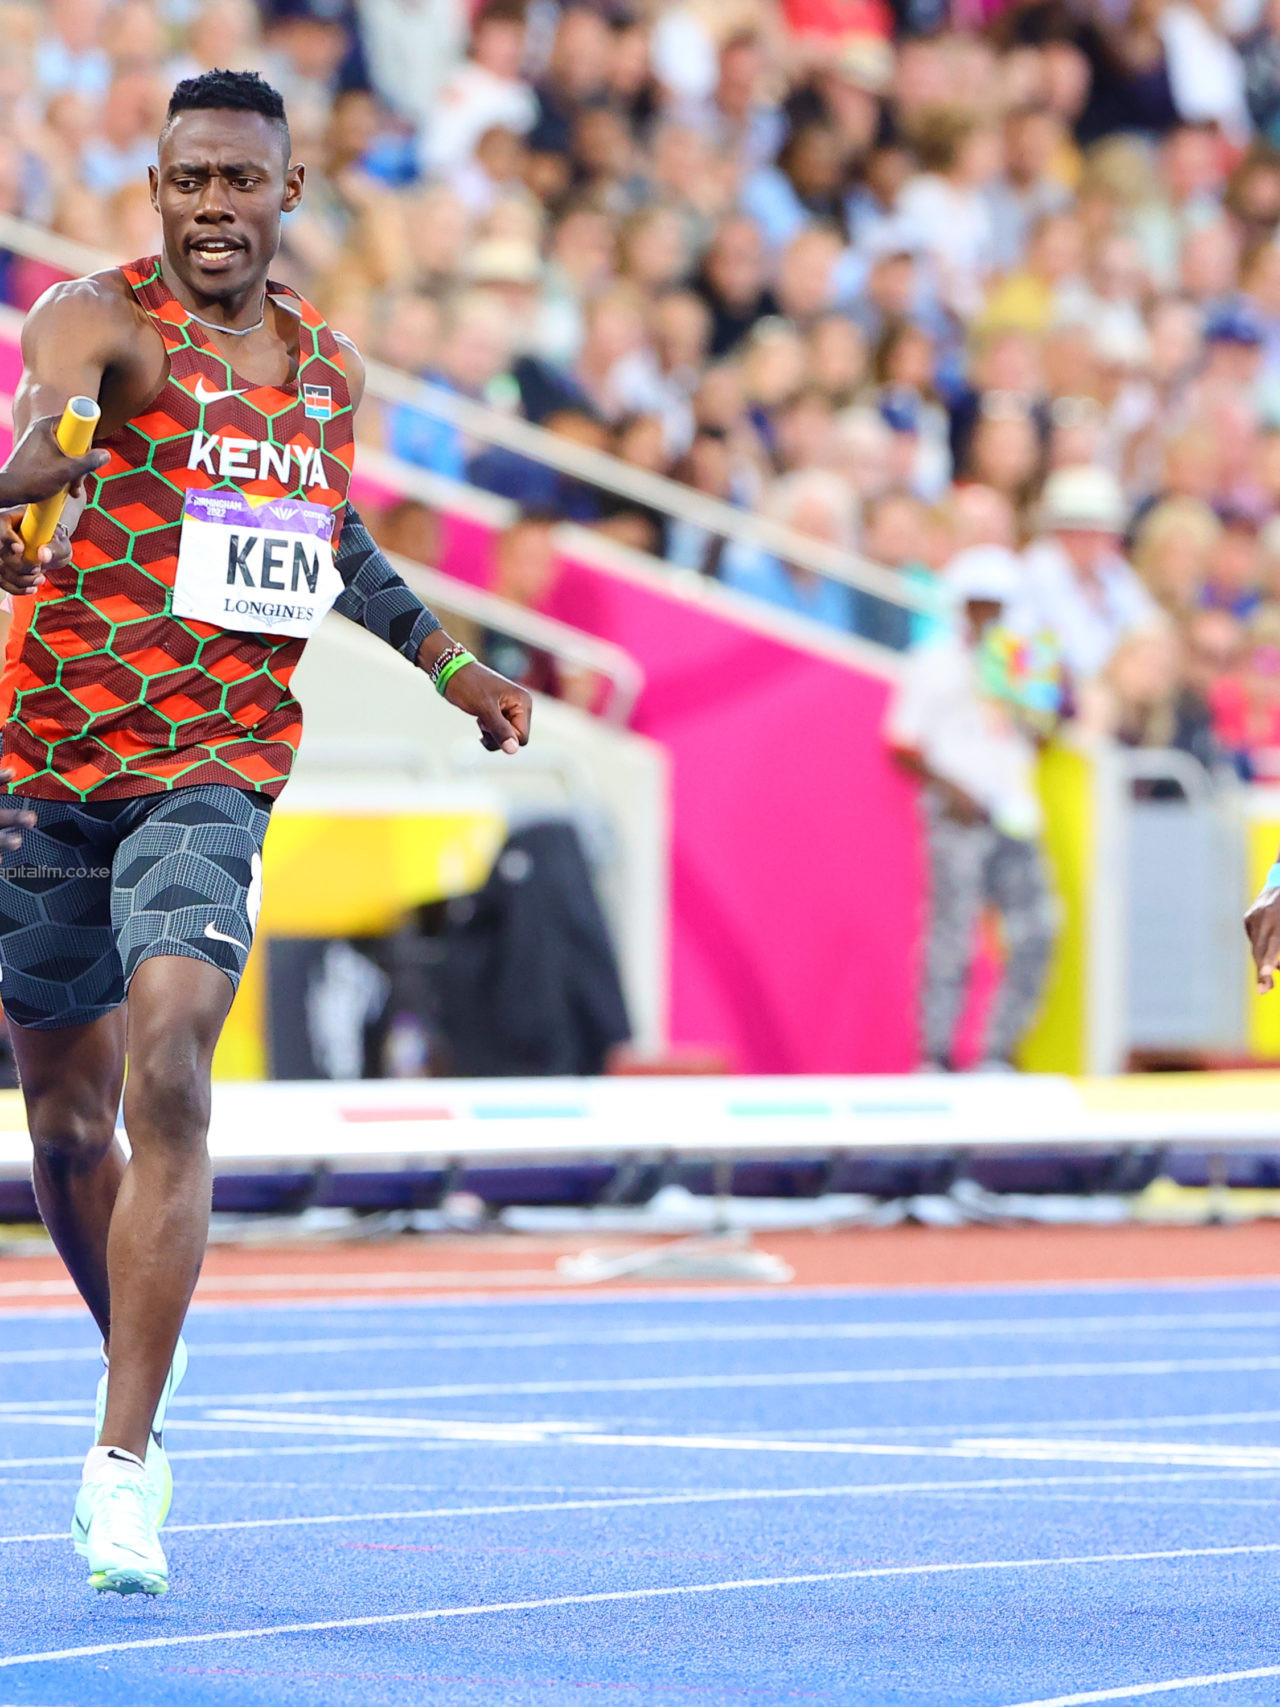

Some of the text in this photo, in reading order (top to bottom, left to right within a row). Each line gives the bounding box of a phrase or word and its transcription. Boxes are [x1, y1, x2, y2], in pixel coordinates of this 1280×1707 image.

[186, 430, 330, 490] KENYA
[226, 534, 320, 594] KEN
[223, 598, 314, 621] LONGINES
